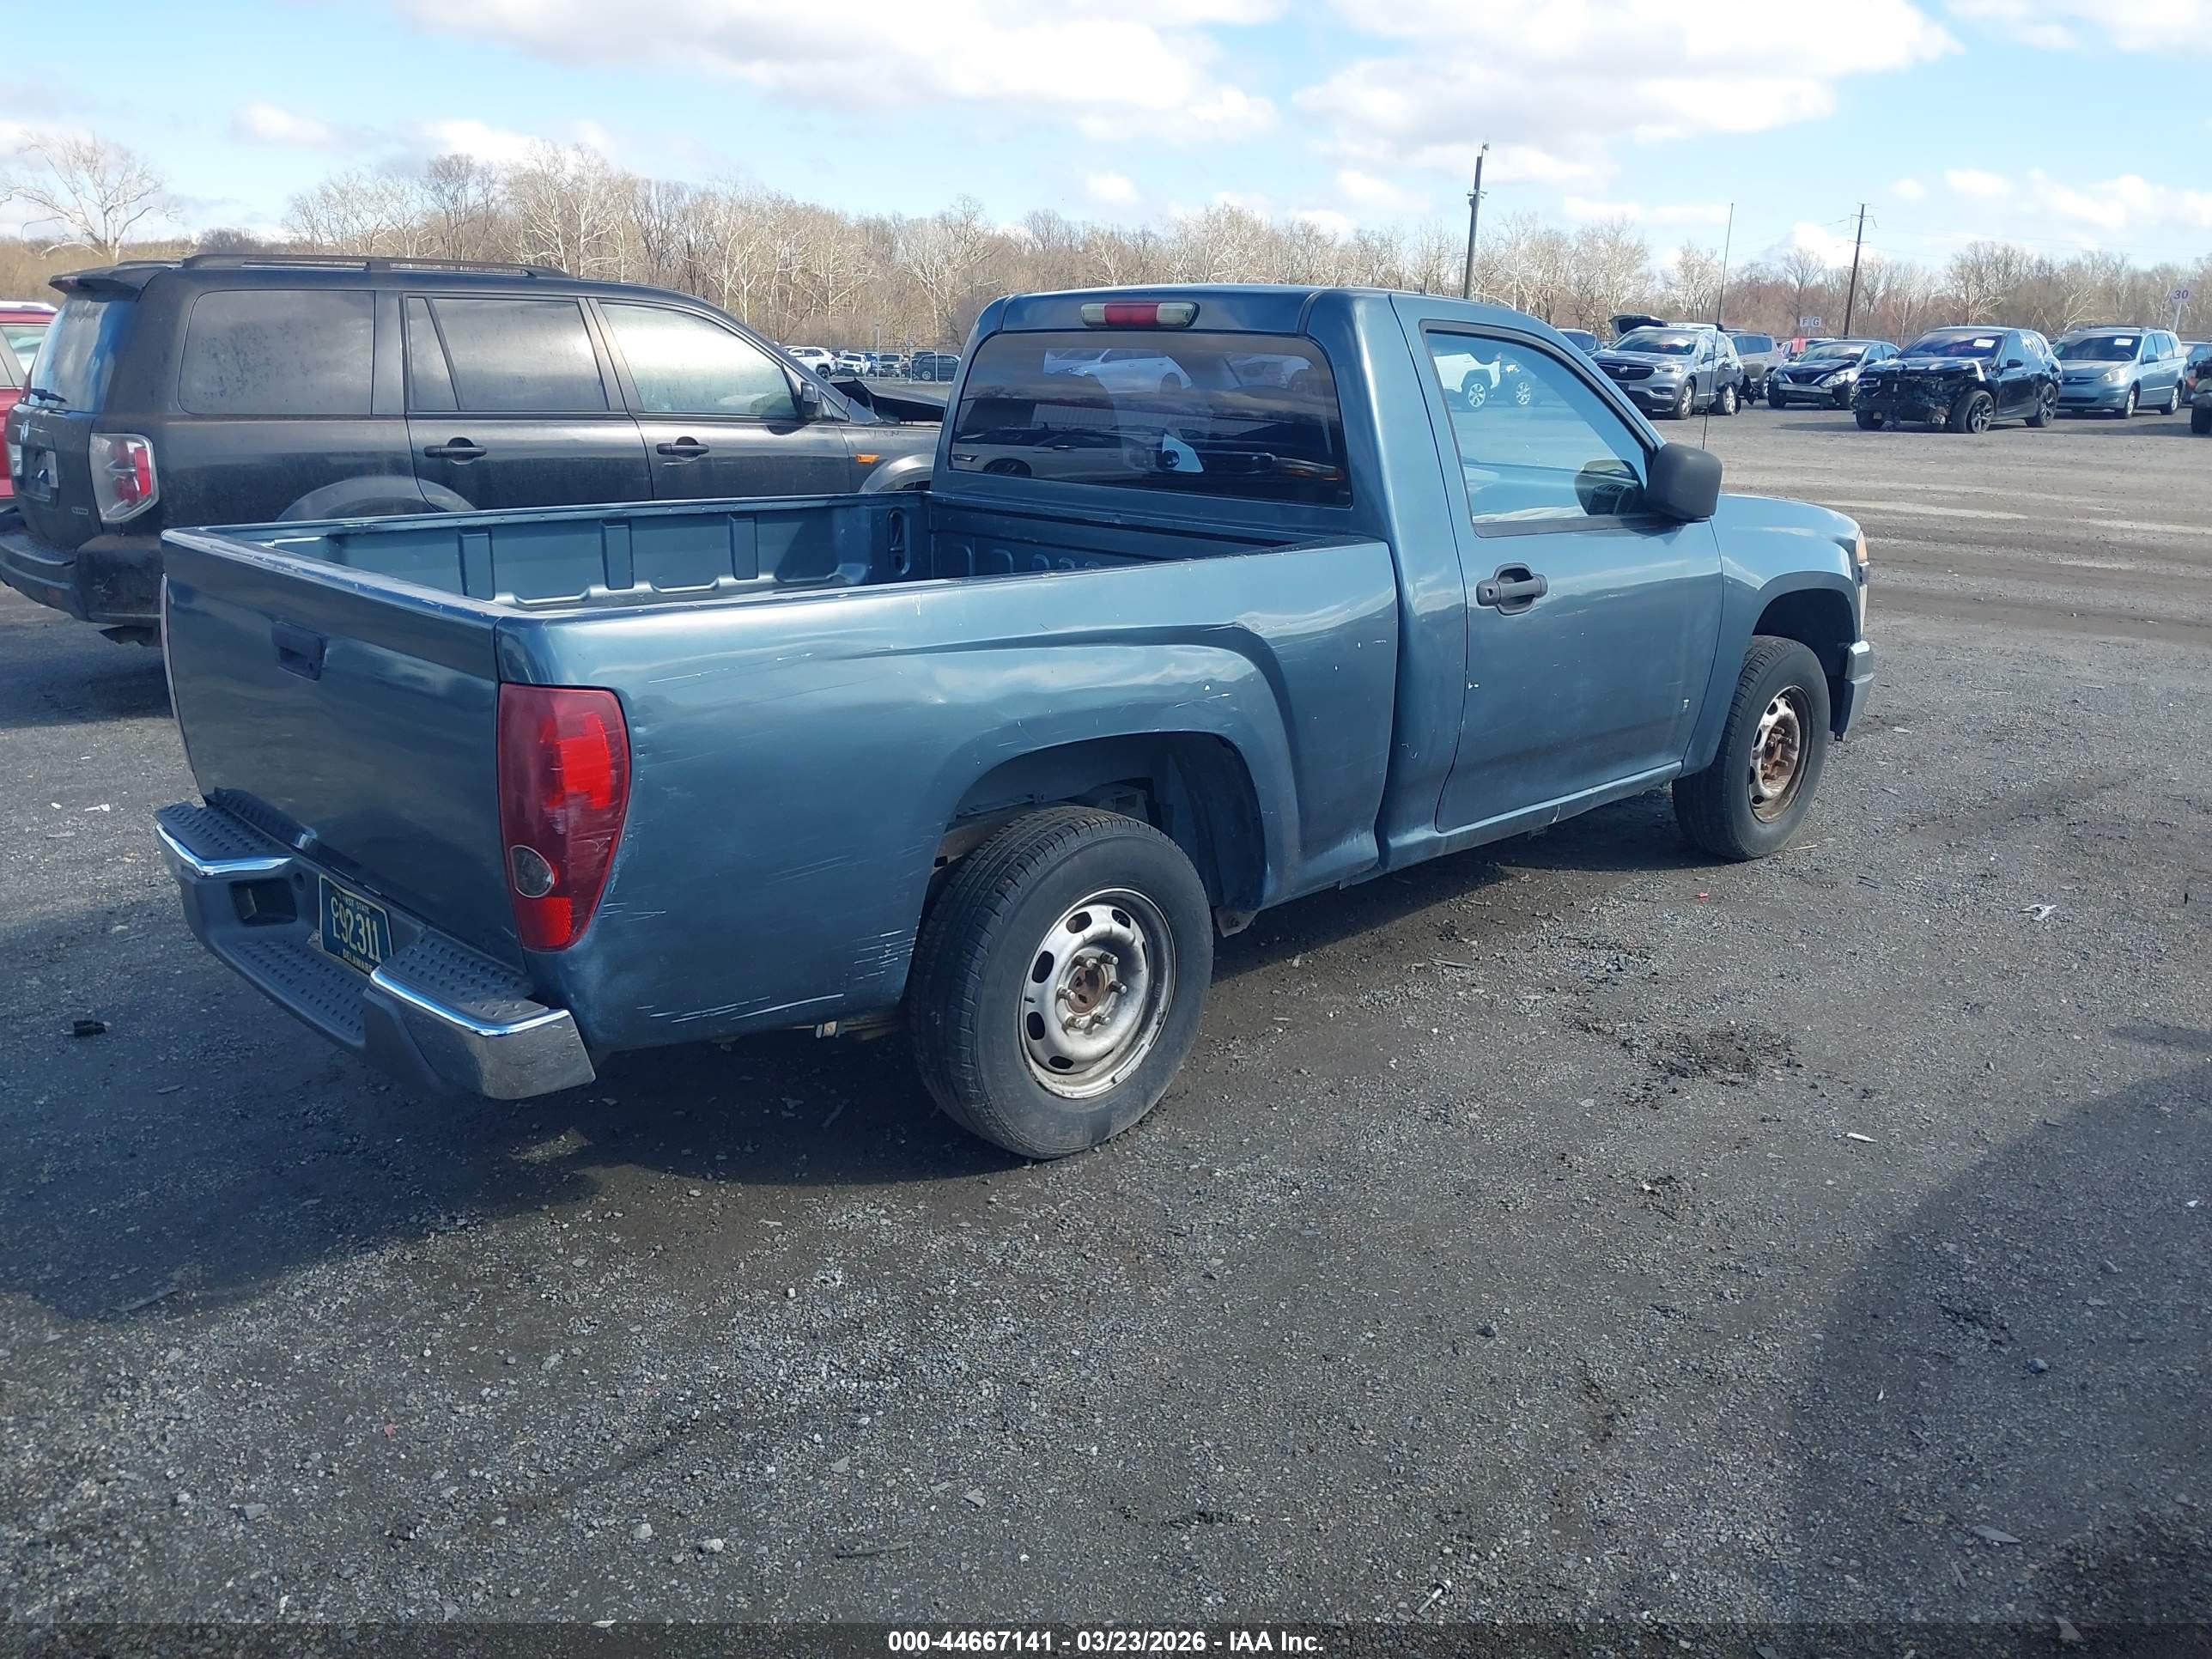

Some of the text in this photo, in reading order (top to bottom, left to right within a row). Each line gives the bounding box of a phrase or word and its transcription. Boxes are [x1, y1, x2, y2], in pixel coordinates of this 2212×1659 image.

[2173, 289, 2189, 300] 30
[1802, 318, 1820, 326] F G
